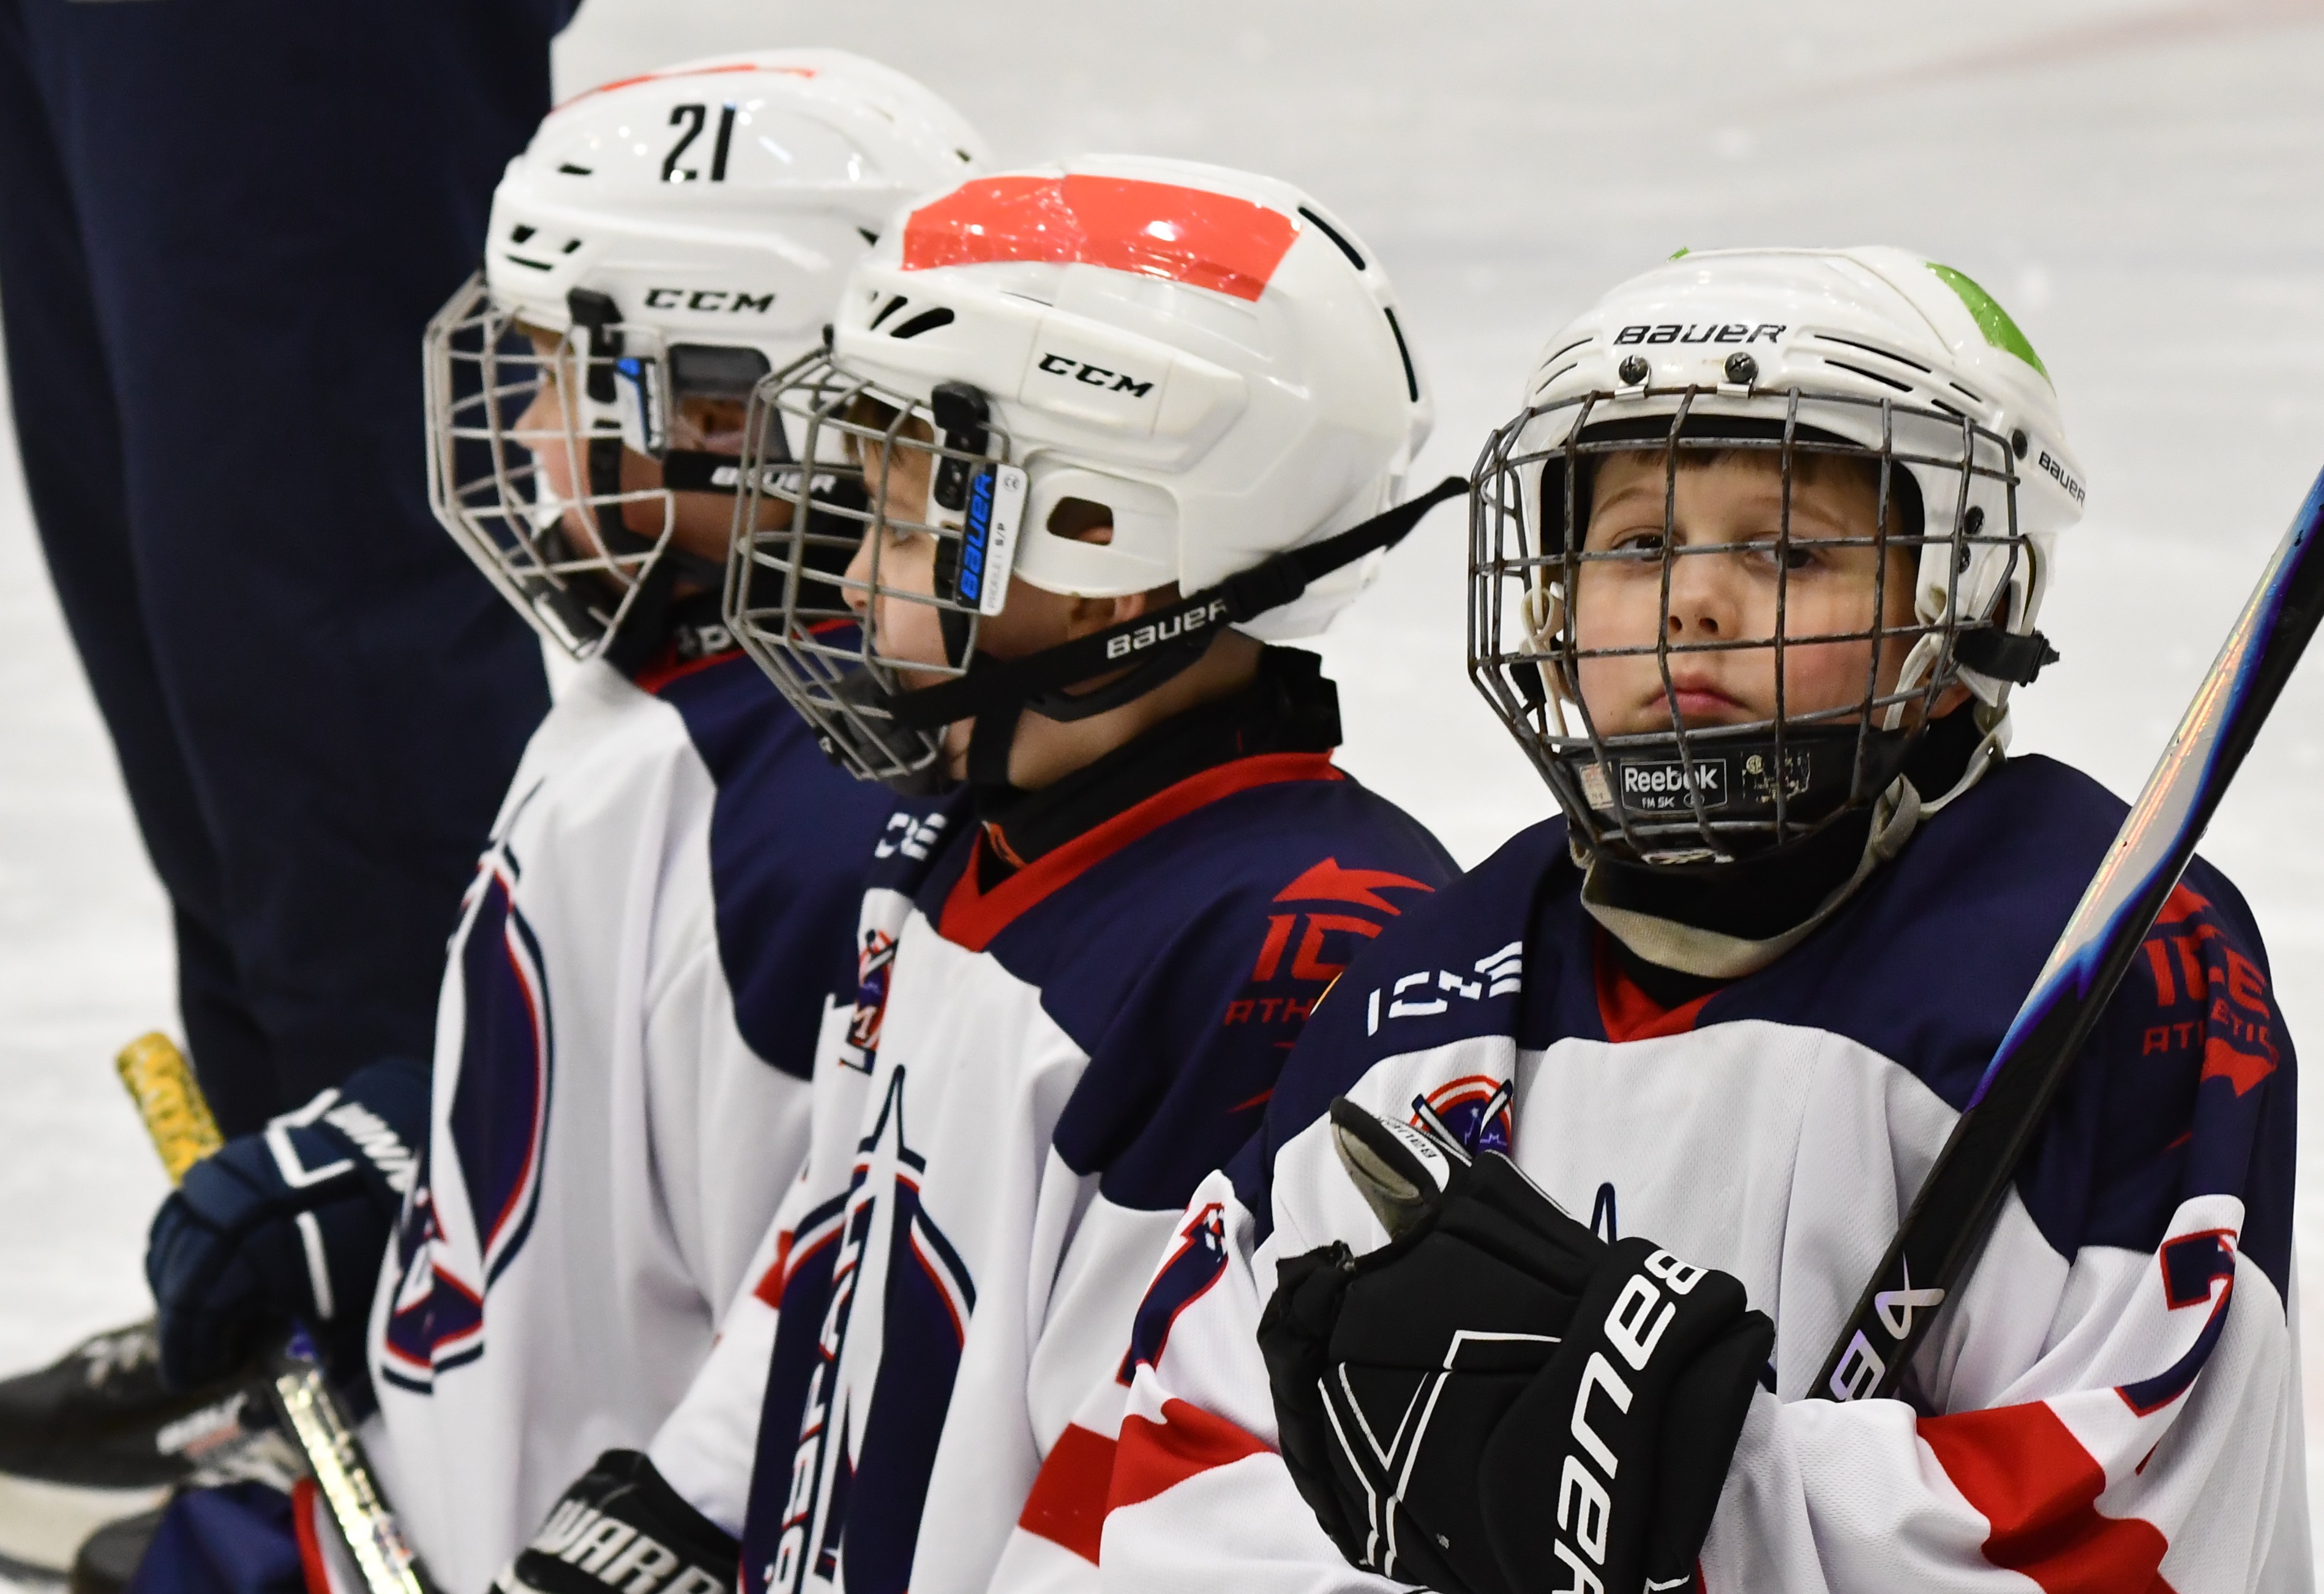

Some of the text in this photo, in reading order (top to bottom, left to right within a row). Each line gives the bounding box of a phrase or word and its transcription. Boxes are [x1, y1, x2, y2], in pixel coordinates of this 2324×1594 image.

[661, 102, 737, 182] 21
[644, 287, 777, 314] CCM
[1613, 323, 1787, 347] BAUER
[1038, 352, 1155, 399] CCM
[2038, 450, 2085, 508] BAUER
[960, 473, 993, 601] BAUER
[1106, 599, 1228, 660] BAUER
[1624, 764, 1719, 793] Reebok
[1551, 1249, 1709, 1594] BAUER
